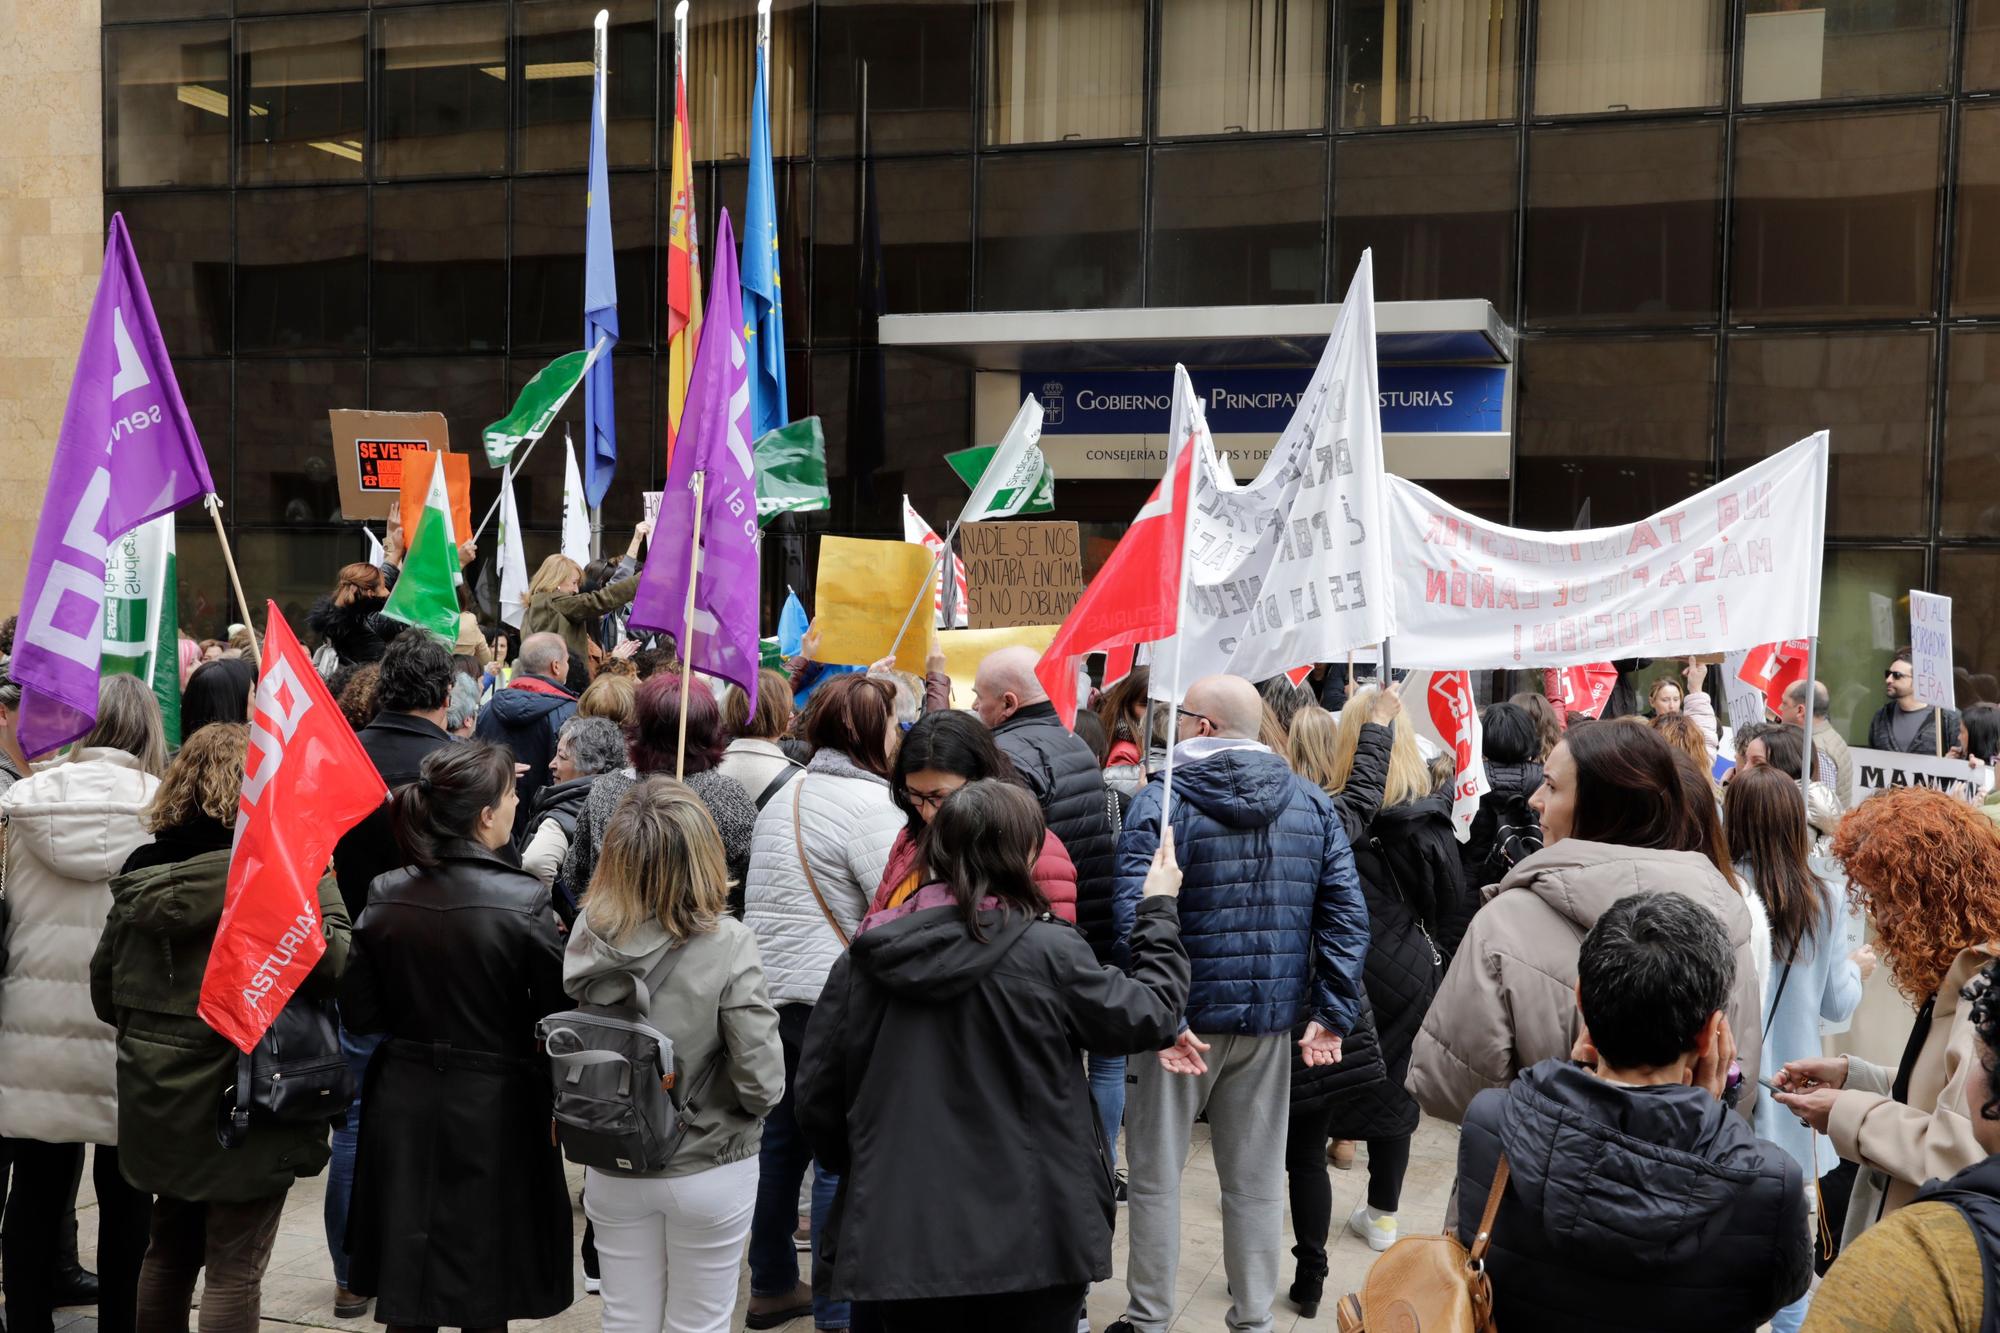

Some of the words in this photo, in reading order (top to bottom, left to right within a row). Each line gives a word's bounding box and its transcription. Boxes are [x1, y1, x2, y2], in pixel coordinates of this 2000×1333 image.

[1076, 389, 1171, 411] GOBIERNO
[360, 442, 378, 459] SE
[1015, 526, 1040, 557] SE
[1045, 528, 1077, 557] NOS
[990, 589, 1012, 616] NO
